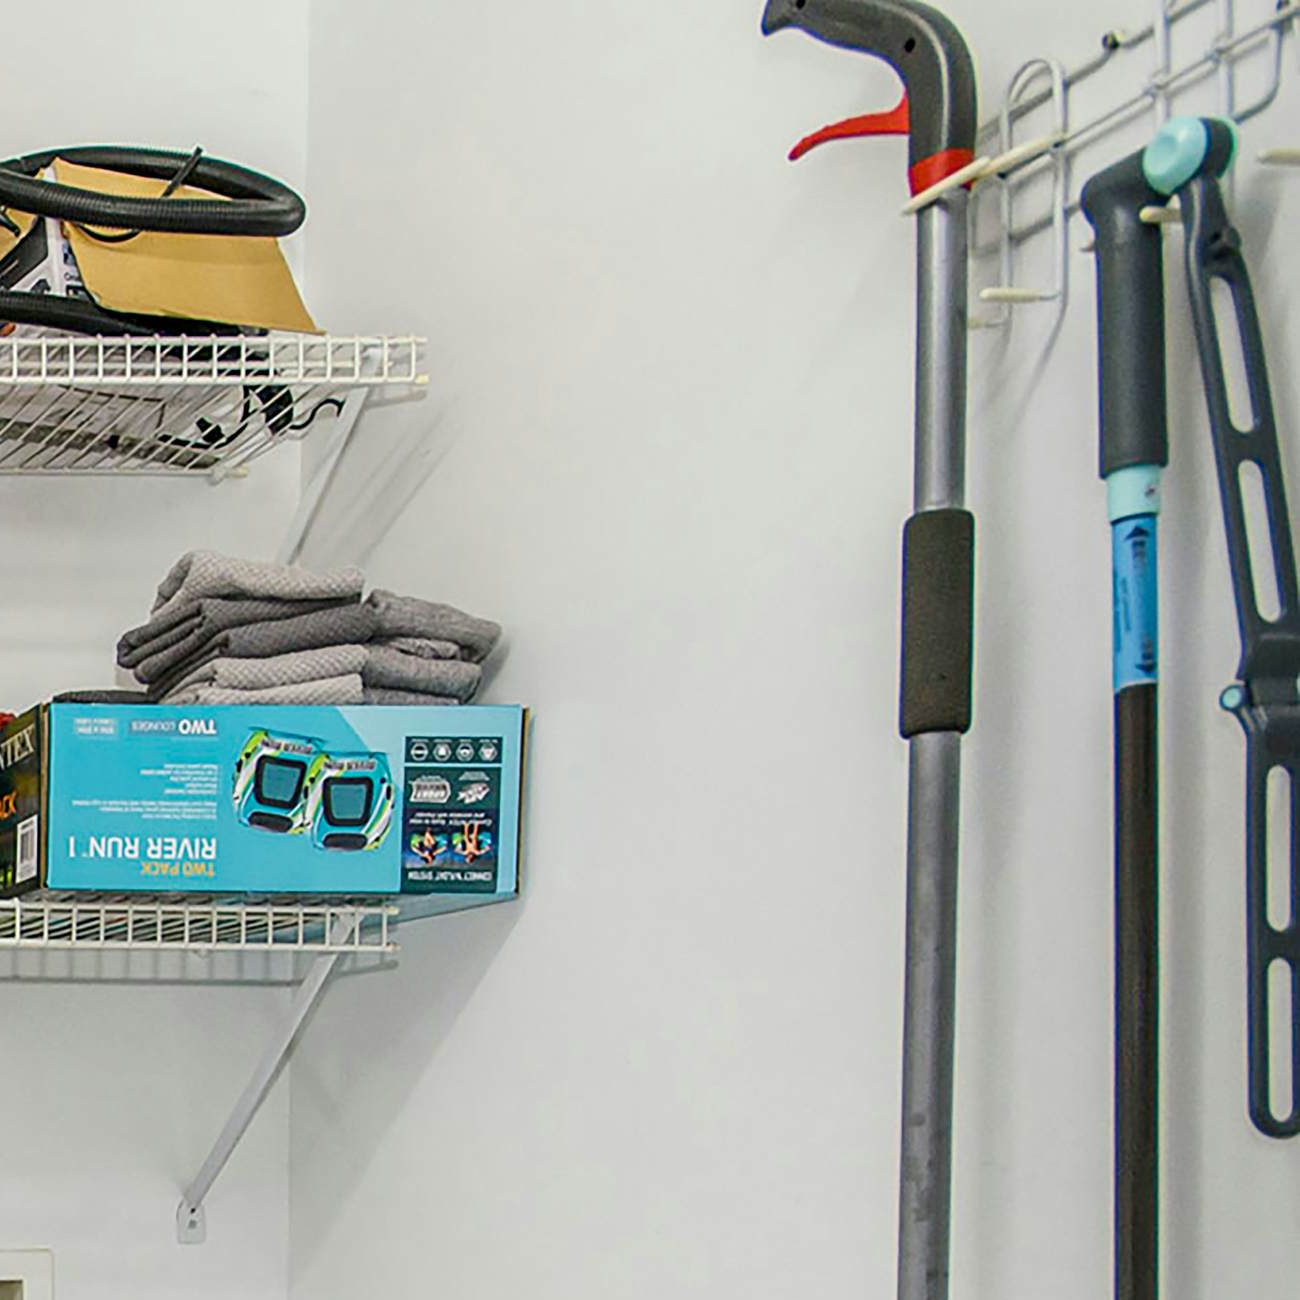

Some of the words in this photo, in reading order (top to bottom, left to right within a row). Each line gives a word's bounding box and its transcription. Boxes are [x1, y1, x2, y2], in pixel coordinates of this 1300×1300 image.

[178, 719, 216, 734] TWO
[90, 837, 139, 859] RUN
[147, 837, 216, 859] RIVER
[141, 860, 178, 876] PACK
[180, 861, 215, 877] TWO
